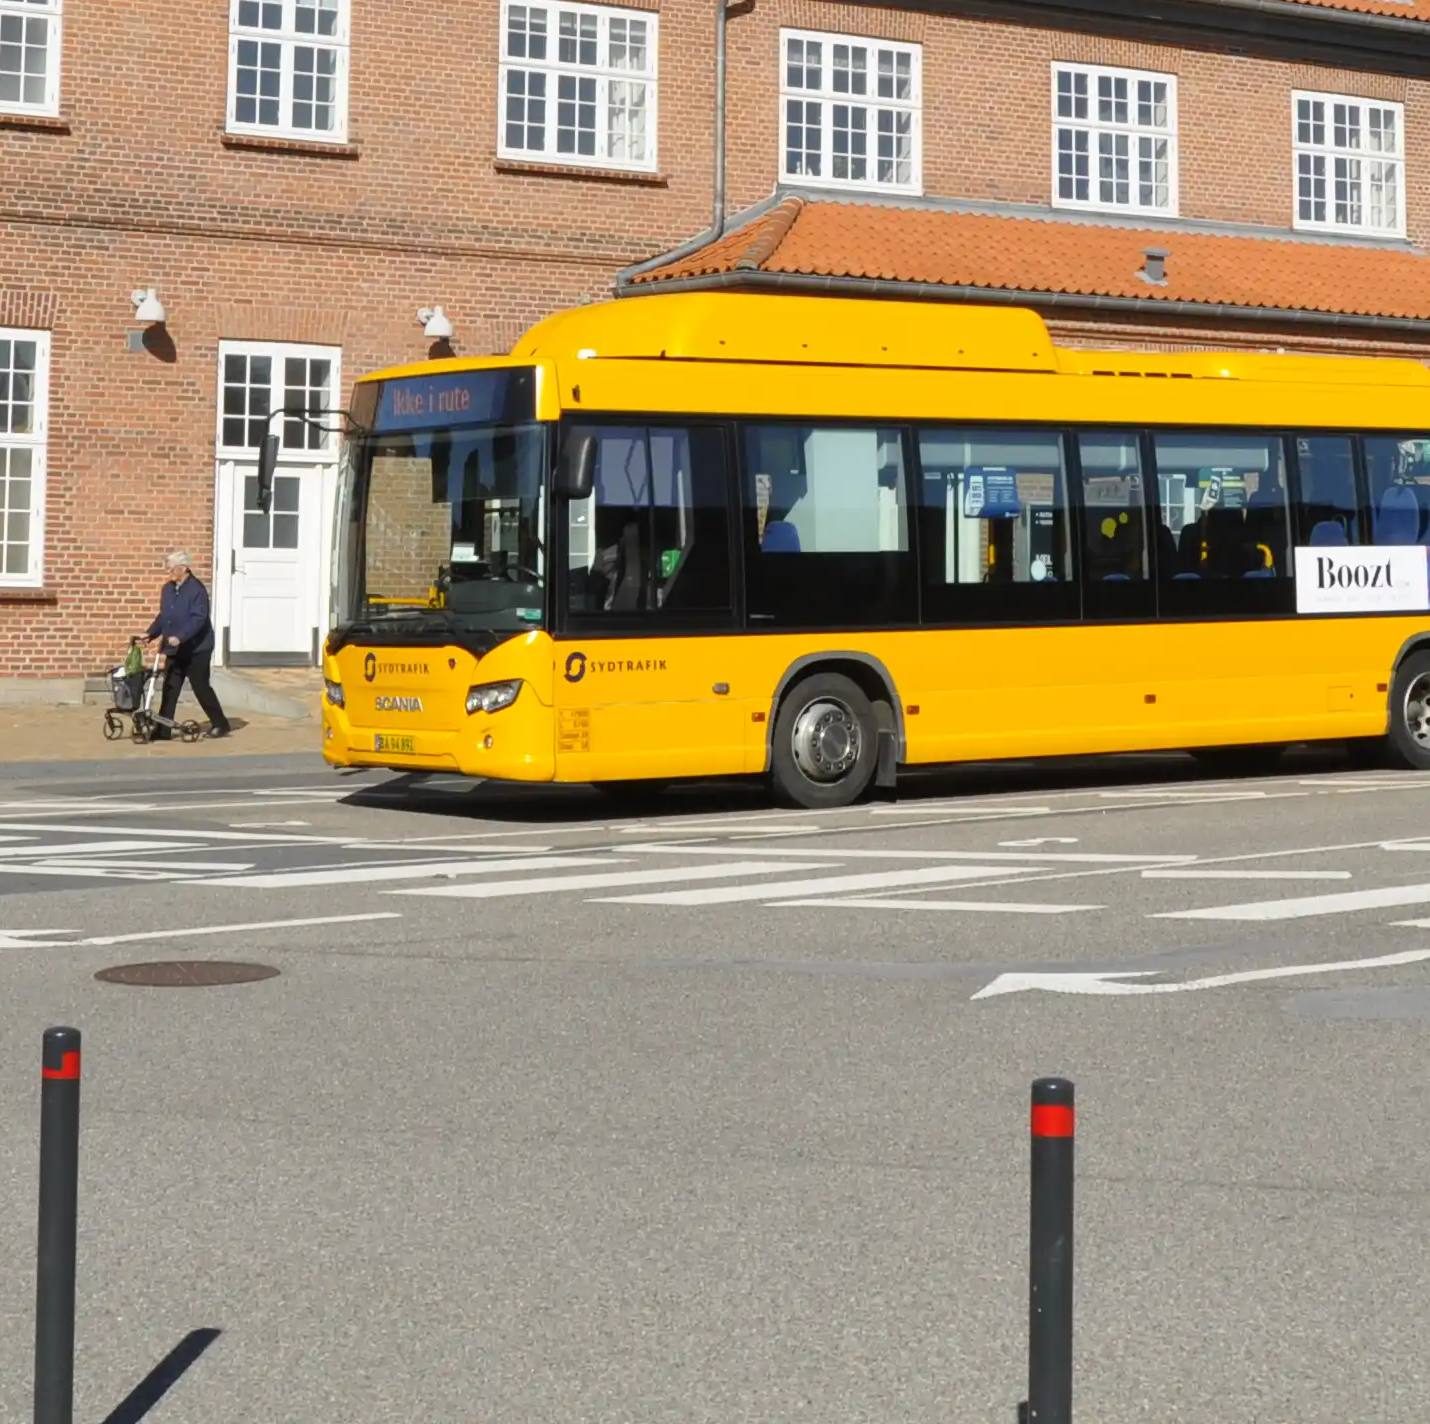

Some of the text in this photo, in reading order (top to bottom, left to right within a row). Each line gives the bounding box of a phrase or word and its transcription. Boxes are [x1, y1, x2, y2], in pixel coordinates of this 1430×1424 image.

[393, 384, 470, 416] Ikke i rute
[1316, 557, 1393, 589] Boozt
[377, 662, 430, 675] SYDTRAFIK
[590, 659, 667, 673] SYDTRAFIK
[375, 696, 424, 712] SCANIA
